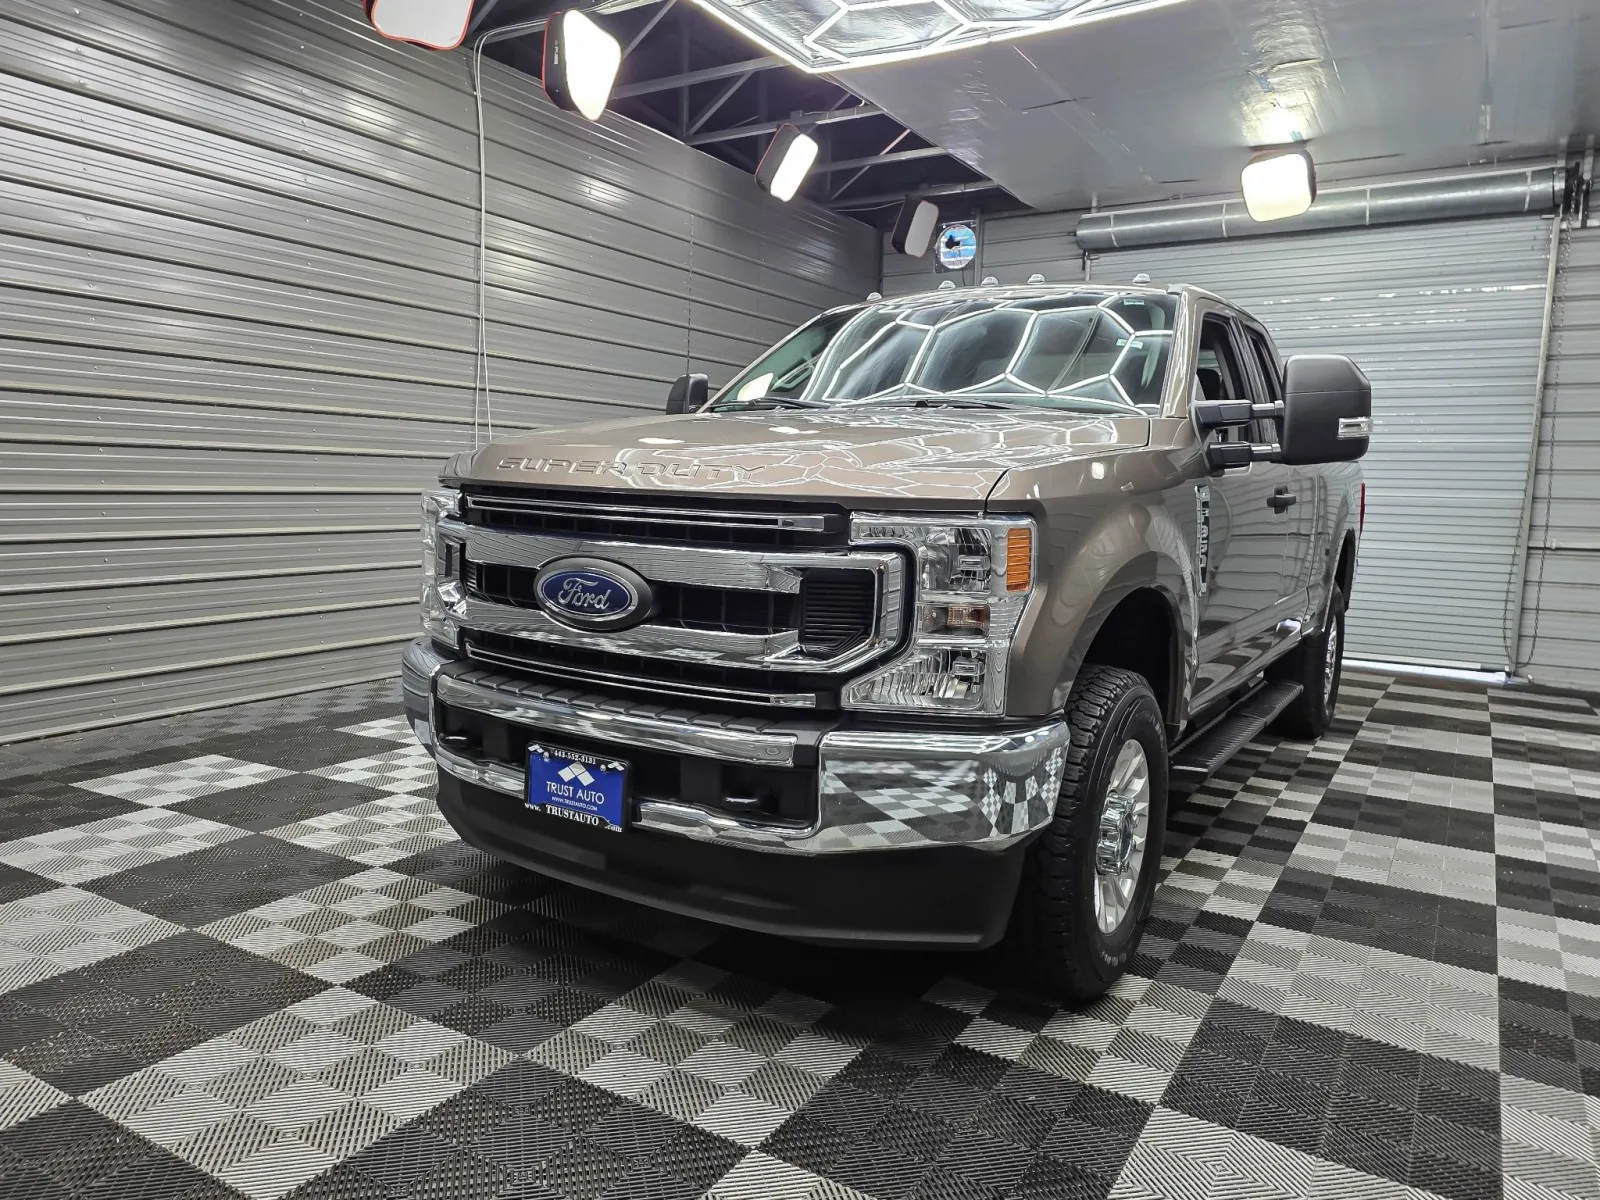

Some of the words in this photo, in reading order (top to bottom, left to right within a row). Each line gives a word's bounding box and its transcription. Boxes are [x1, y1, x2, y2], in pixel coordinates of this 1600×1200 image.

[497, 457, 628, 476] SUPER
[637, 461, 767, 481] DUTY
[557, 576, 610, 611] Ford
[546, 781, 574, 798] TRUST
[576, 790, 605, 805] AUTO
[545, 804, 599, 826] TRUSTAUTO
